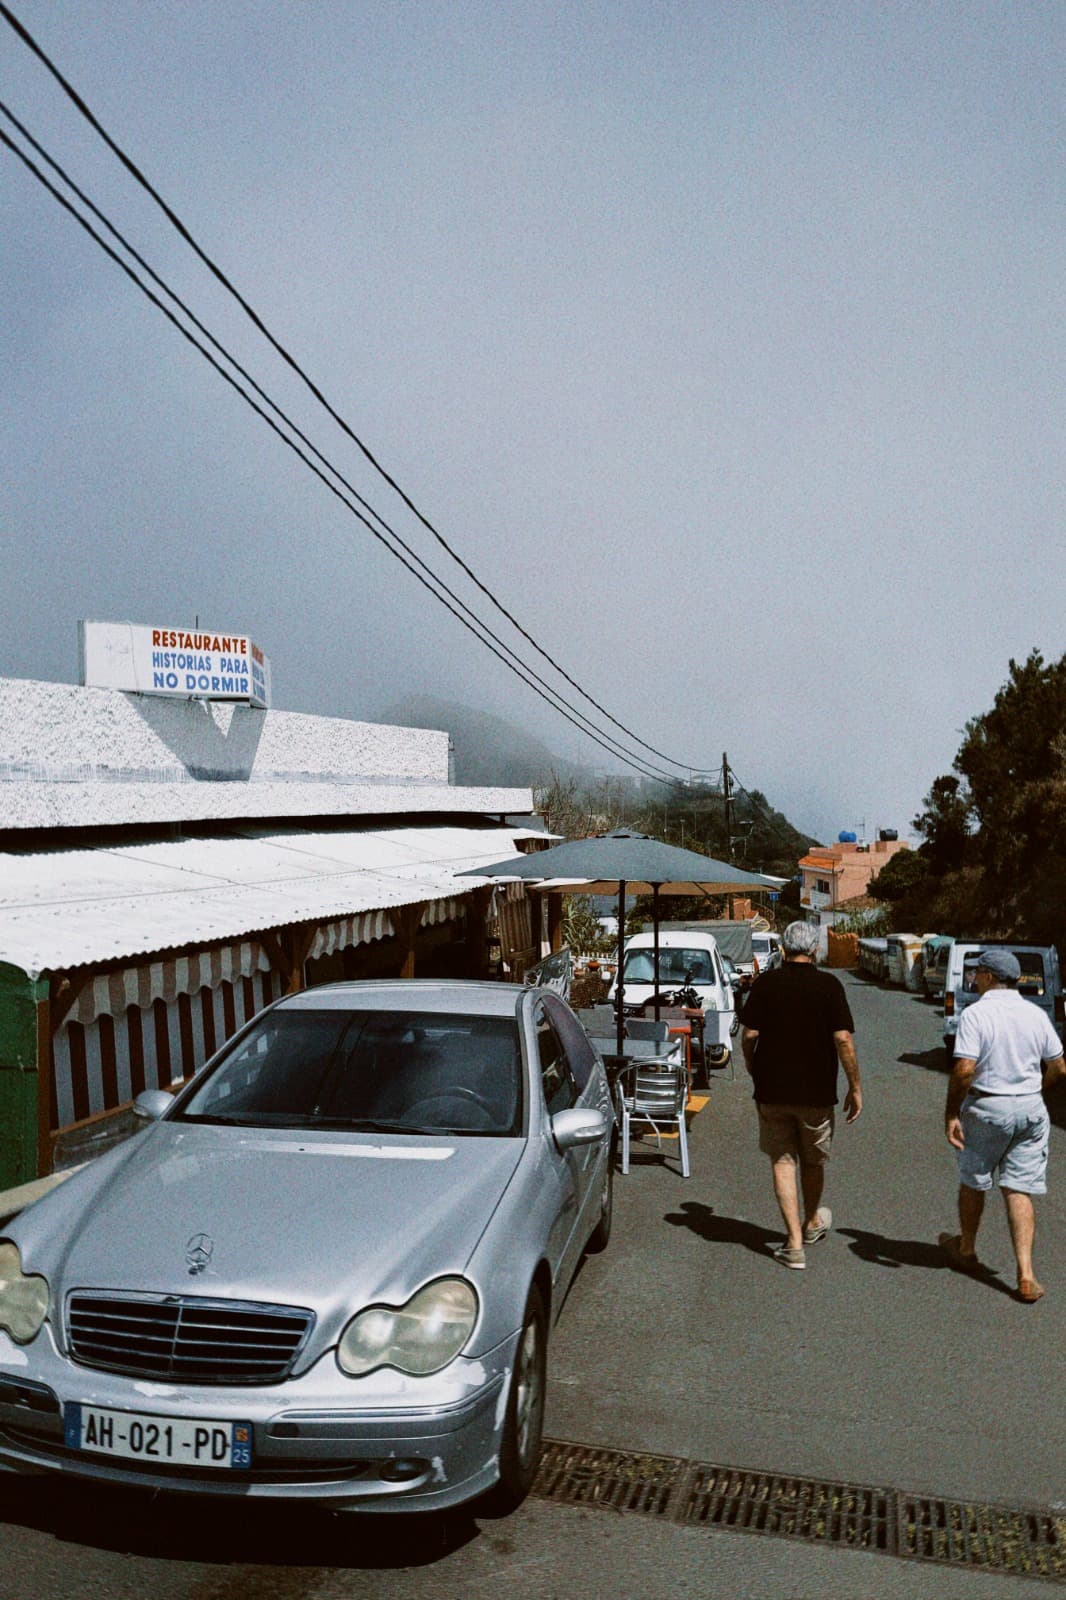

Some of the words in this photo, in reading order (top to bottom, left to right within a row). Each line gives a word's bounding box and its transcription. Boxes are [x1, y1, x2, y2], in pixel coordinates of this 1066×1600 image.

[152, 630, 247, 654] RESTAURANTE
[152, 652, 212, 671] HISTORIAS
[220, 657, 249, 674] PARA
[153, 672, 178, 689] NO
[186, 674, 249, 693] DORMIR
[86, 1414, 228, 1460] AH-021-PD
[233, 1449, 249, 1463] 25
